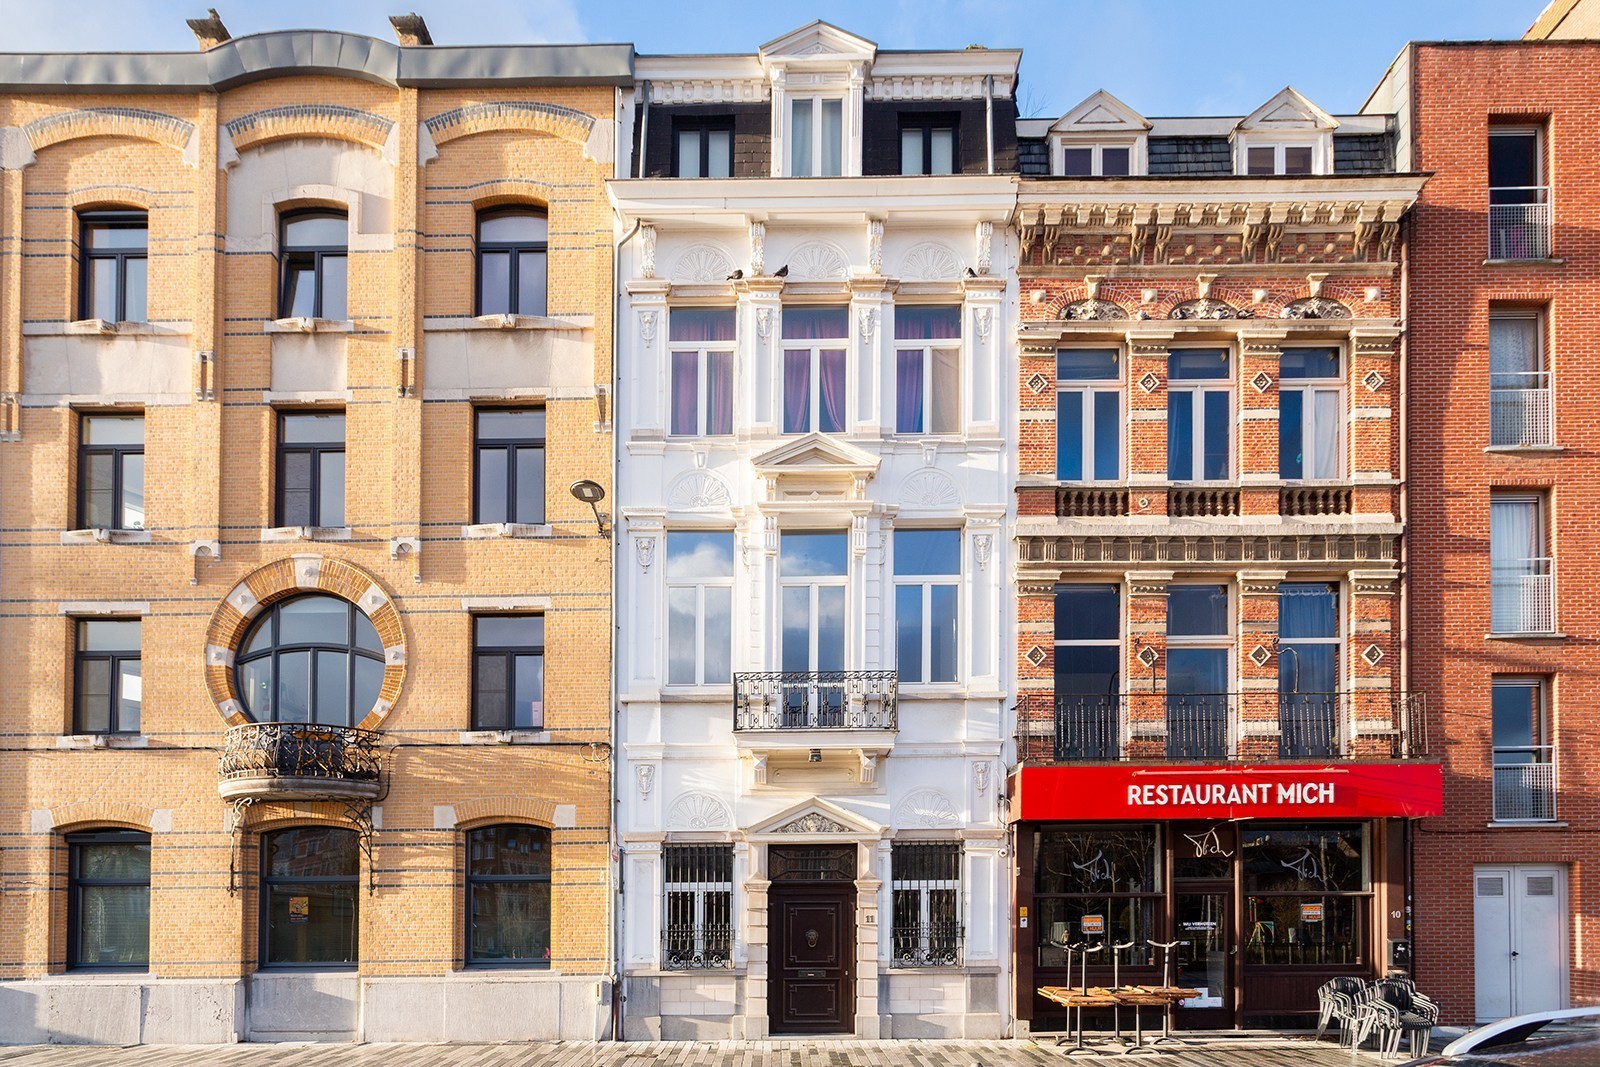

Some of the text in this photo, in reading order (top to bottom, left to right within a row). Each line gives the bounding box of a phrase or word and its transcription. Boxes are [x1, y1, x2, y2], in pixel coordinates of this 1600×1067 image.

[1127, 782, 1335, 805] RESTAURANT MICH
[865, 914, 876, 923] 11
[1391, 910, 1402, 919] 10
